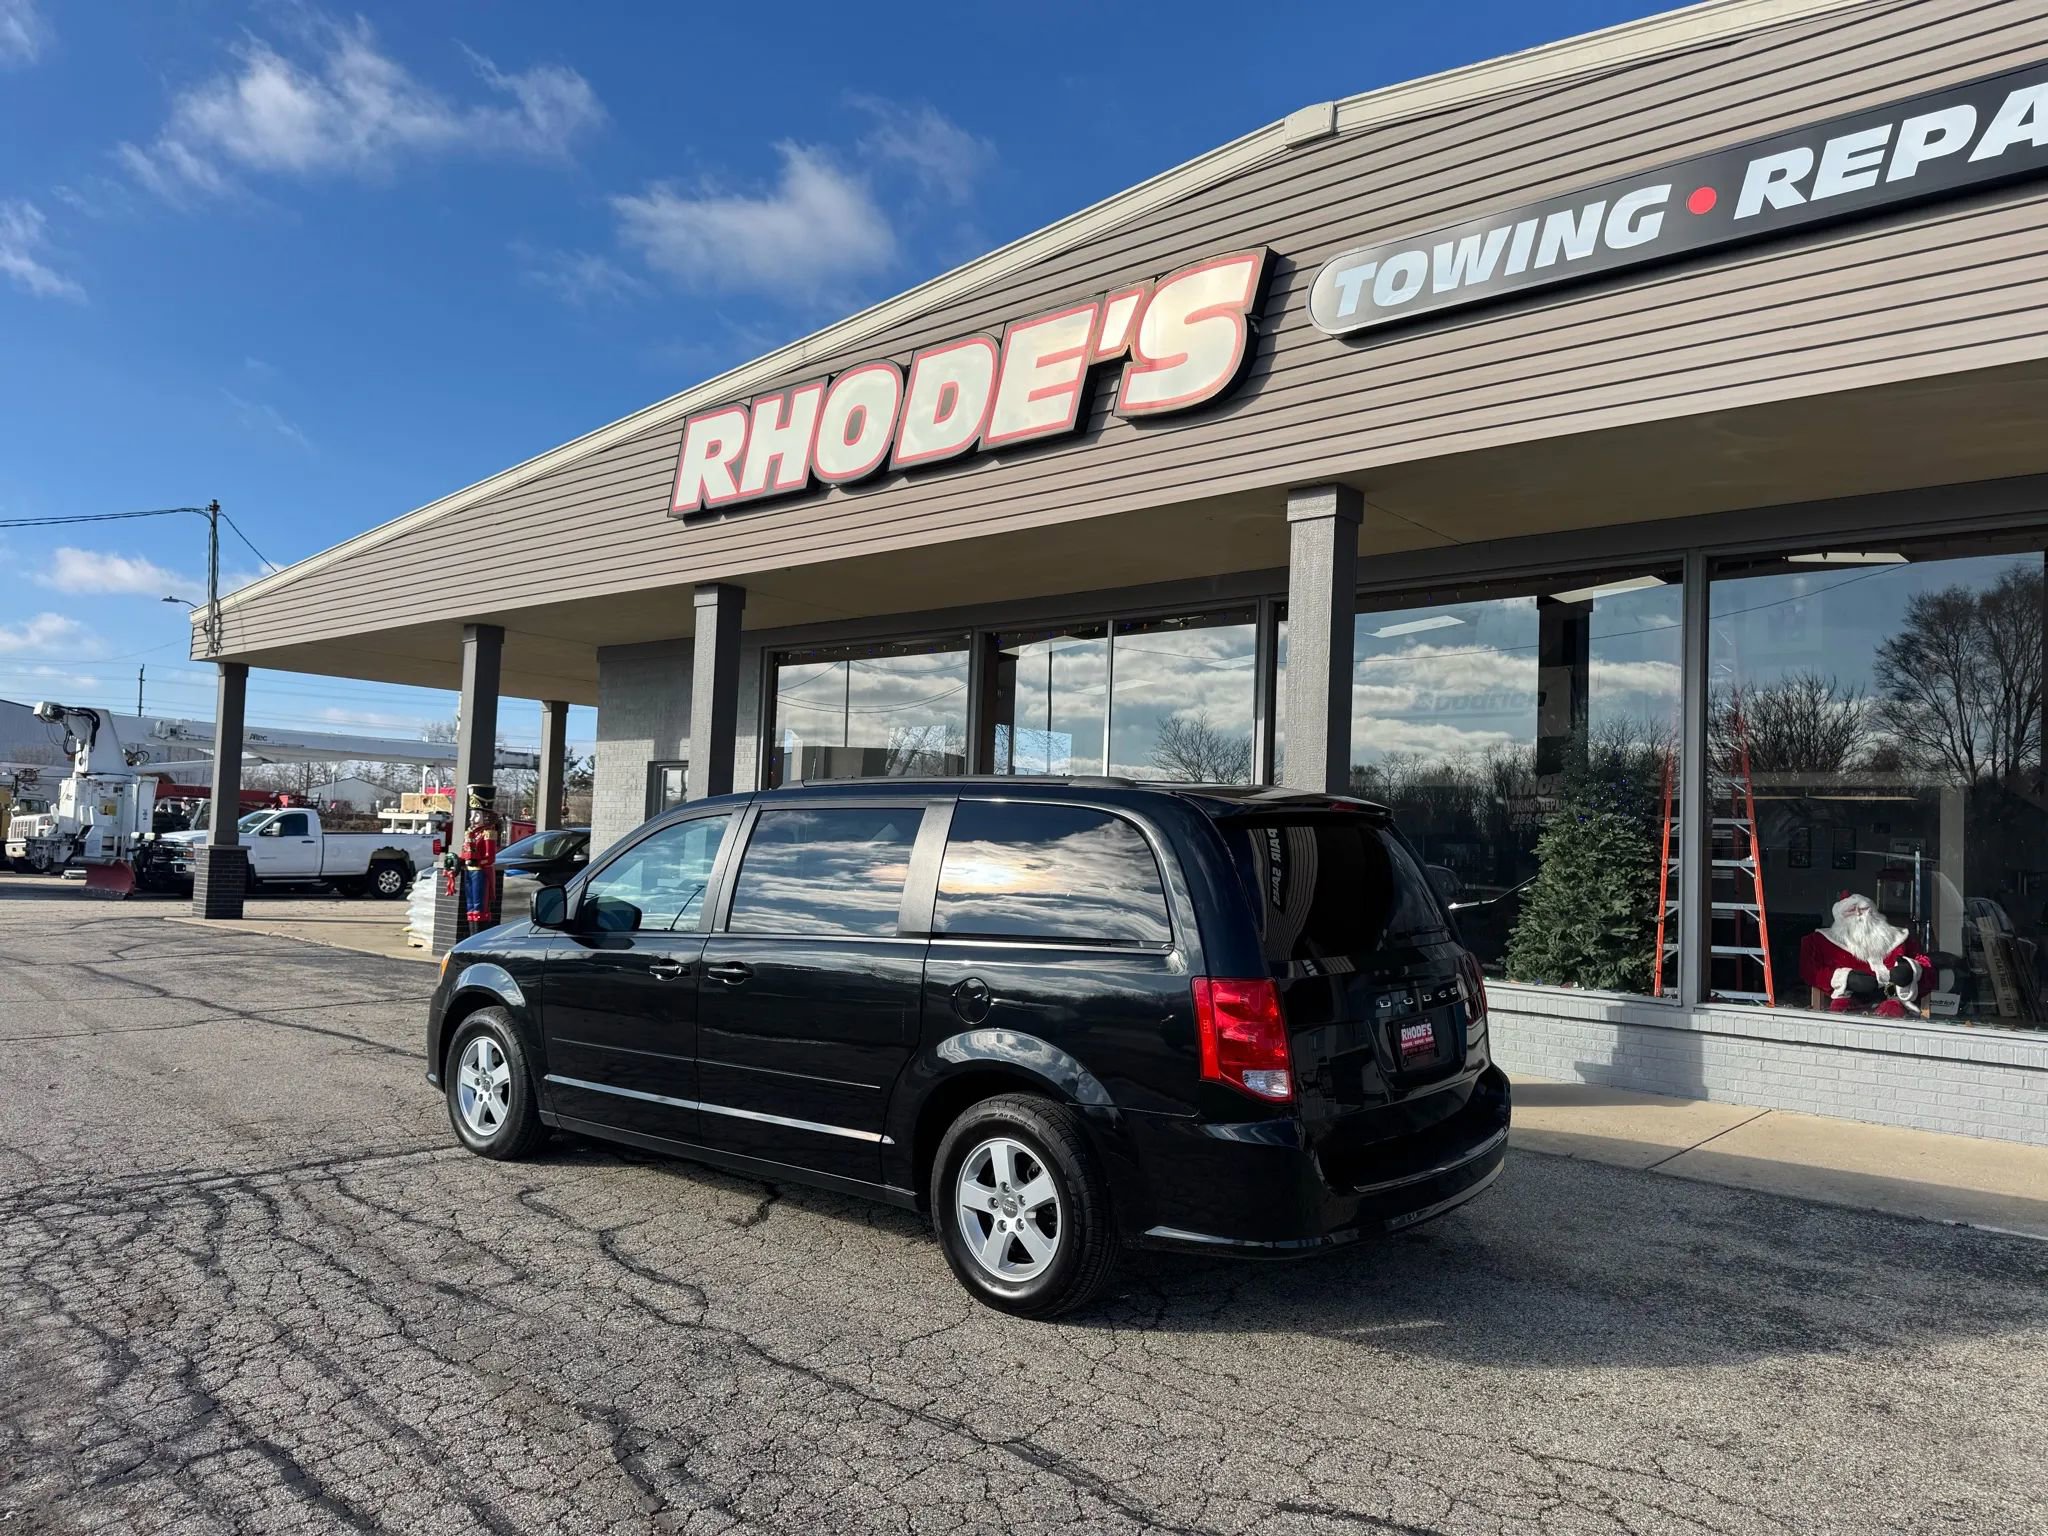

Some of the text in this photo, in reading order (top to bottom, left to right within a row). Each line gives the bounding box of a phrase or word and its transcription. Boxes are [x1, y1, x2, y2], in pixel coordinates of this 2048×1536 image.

[1333, 183, 1673, 320] TOWING
[670, 249, 1266, 515] RHODE'S
[1400, 1022, 1433, 1042] RHODE'S
